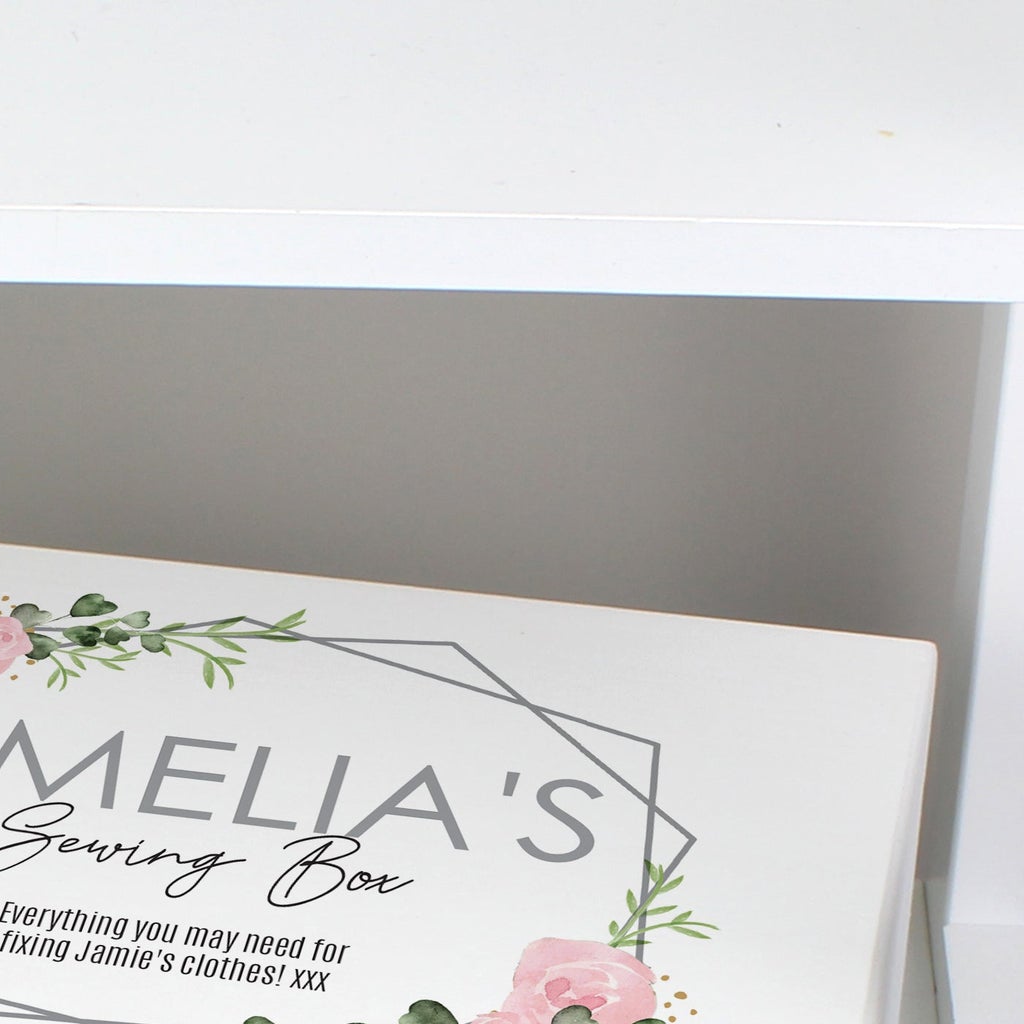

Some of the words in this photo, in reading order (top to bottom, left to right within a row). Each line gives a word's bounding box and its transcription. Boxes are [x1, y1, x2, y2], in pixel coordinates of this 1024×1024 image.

[267, 835, 414, 907] Box
[0, 902, 128, 940] Everything
[132, 920, 178, 943] you
[184, 927, 239, 953] may
[243, 934, 305, 958] need
[312, 939, 350, 964] for
[0, 931, 70, 962] fixing
[75, 940, 175, 973] Jamie's
[181, 954, 286, 986] clothes!
